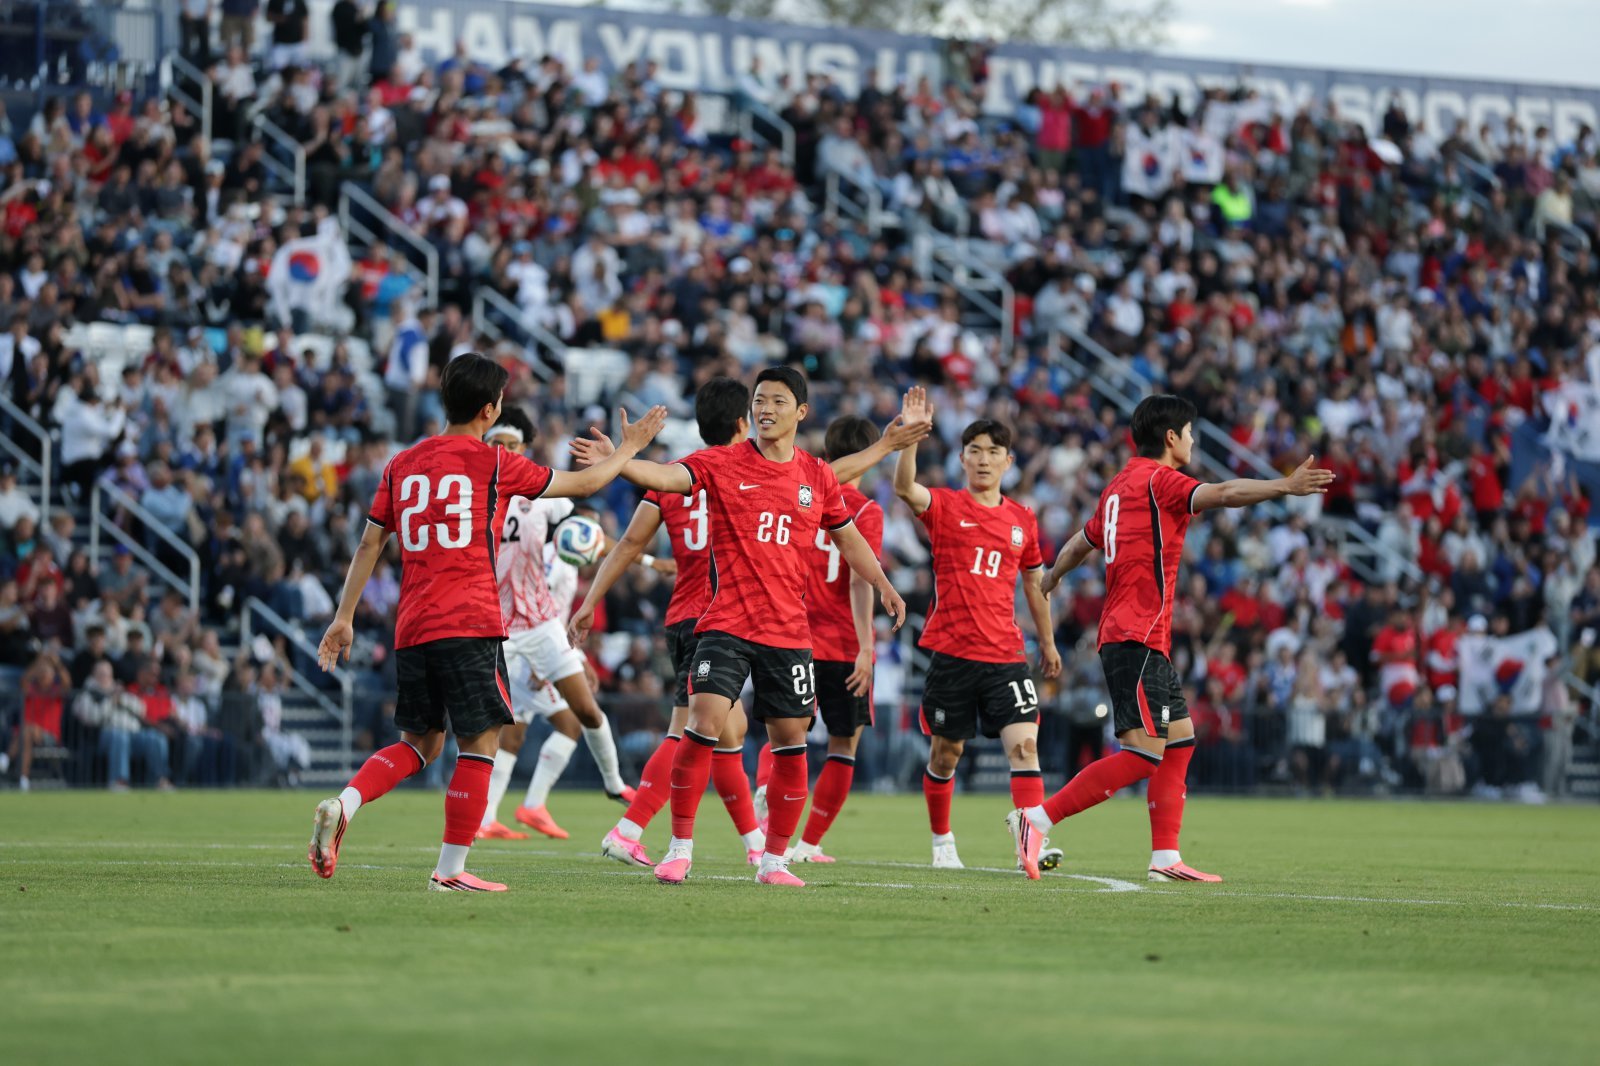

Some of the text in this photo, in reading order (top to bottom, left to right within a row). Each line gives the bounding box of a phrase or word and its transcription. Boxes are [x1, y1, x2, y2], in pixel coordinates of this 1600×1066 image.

[399, 474, 473, 552] 23
[682, 488, 709, 551] 3
[757, 511, 792, 546] 26
[1103, 493, 1120, 565] 8
[969, 546, 1002, 578] 19
[1008, 679, 1039, 708] 19
